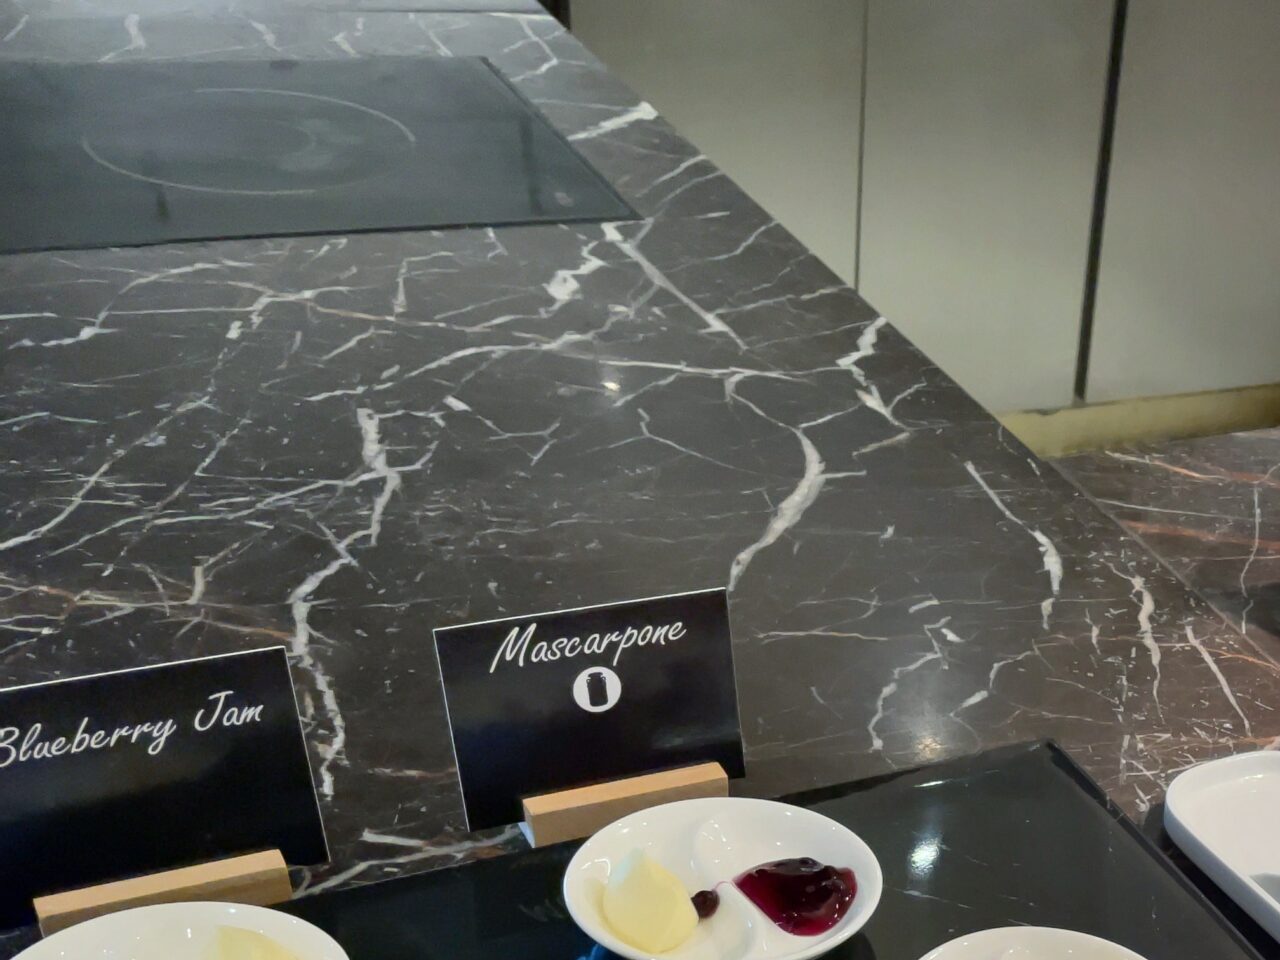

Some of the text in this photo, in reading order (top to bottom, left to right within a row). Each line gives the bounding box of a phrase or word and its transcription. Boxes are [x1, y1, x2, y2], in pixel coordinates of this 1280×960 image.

[489, 622, 687, 673] Mascarpone
[0, 690, 265, 768] Blueberry Jam
